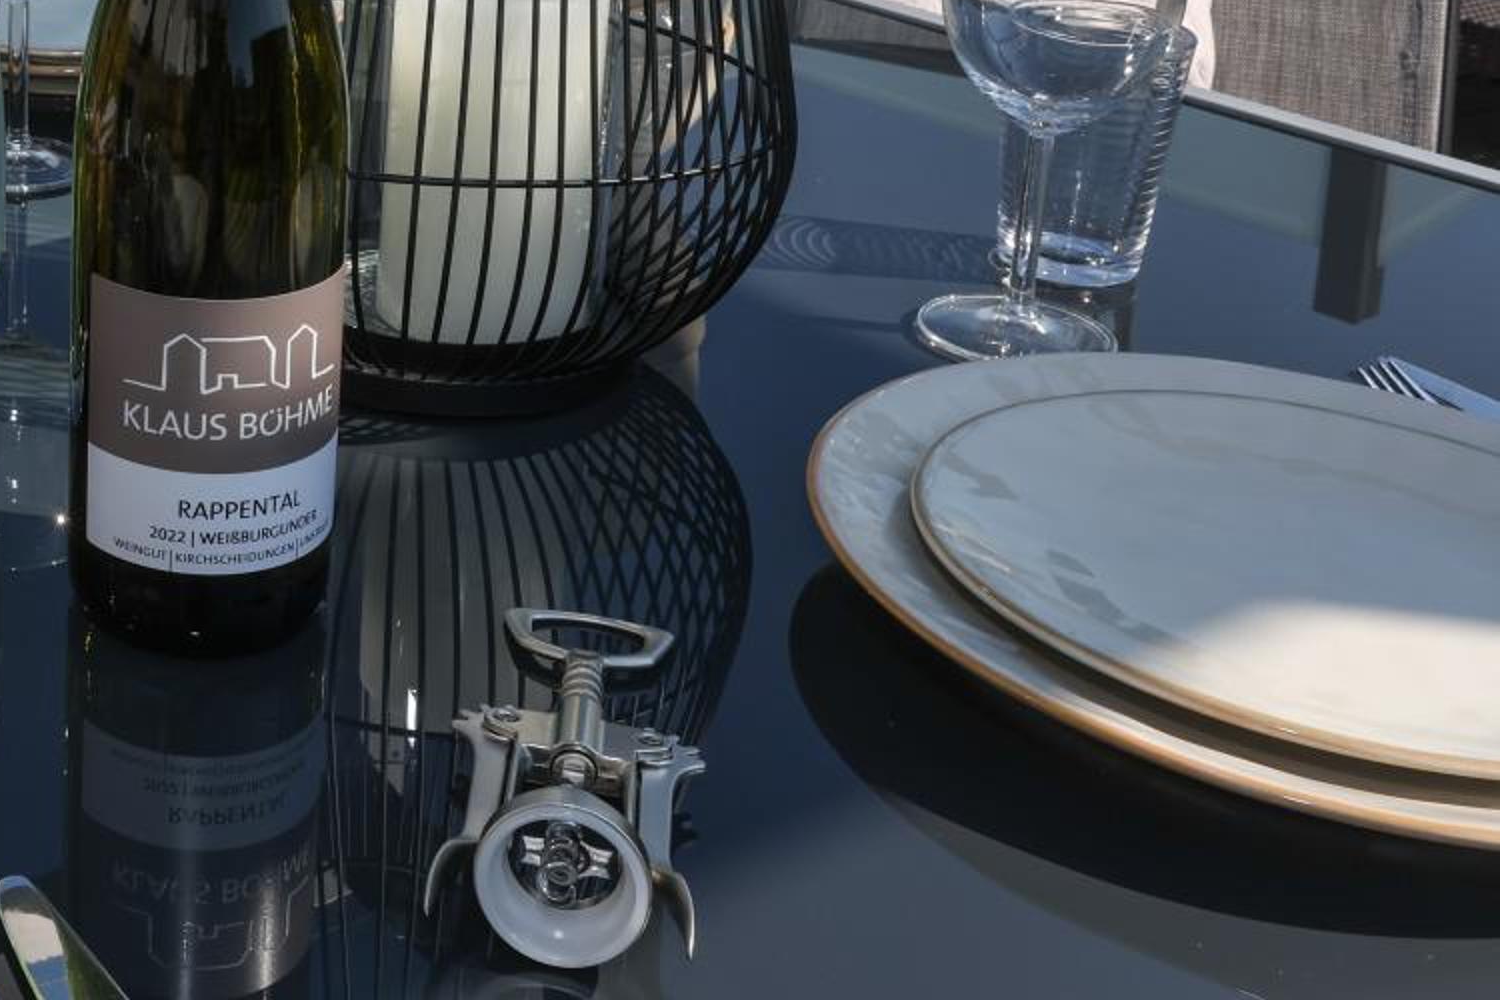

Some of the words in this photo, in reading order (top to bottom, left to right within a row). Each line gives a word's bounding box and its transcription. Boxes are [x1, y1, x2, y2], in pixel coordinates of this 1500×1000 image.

[122, 399, 228, 441] KLAUS
[239, 383, 333, 440] BÖHME
[178, 490, 301, 520] RAPPENTAL
[149, 525, 187, 545] 2022
